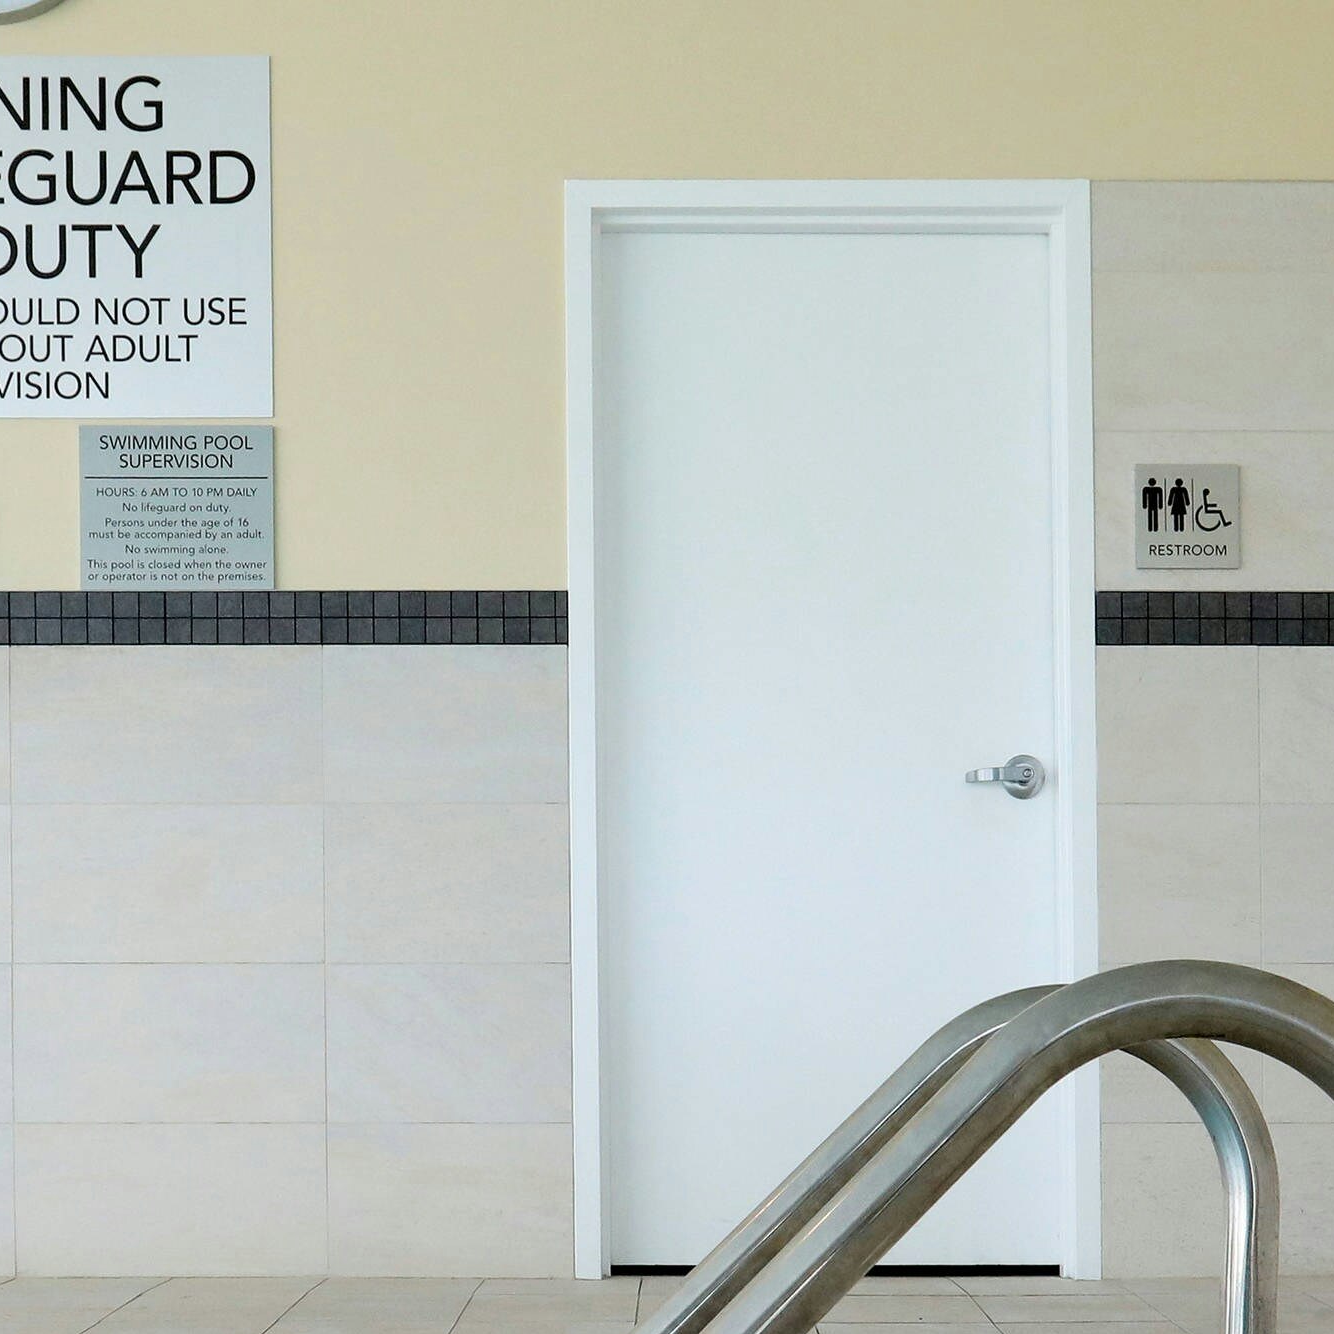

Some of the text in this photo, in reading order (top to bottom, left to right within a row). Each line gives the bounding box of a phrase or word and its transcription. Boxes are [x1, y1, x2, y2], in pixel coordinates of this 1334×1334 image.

[95, 297, 171, 326] NOT
[183, 297, 247, 326] USE
[84, 334, 199, 363] ADULT
[99, 434, 254, 450] SWIMMING POOL
[119, 453, 233, 469] SUPERVISION
[96, 487, 258, 497] HOURS: 6 AM TO 10 PM DAILY
[122, 502, 138, 512] No
[141, 502, 186, 515] lifeguard
[206, 502, 231, 515] duty.
[105, 518, 249, 530] Persons under the age of 16
[89, 531, 114, 539] must
[117, 529, 131, 539] be
[134, 529, 202, 541] accompanied
[205, 529, 217, 541] by
[236, 529, 264, 539] adult.
[125, 544, 229, 556] No swimming alone.
[1149, 544, 1227, 556] RESTROOM
[87, 559, 108, 569] This
[111, 559, 134, 571] pool
[137, 560, 145, 569] is
[148, 559, 181, 569] closed
[184, 559, 212, 569] when
[215, 559, 232, 569] the
[102, 571, 146, 584] operator
[150, 571, 158, 581] is
[161, 573, 178, 581] not
[197, 571, 215, 581] the
[217, 571, 266, 584] premises.
